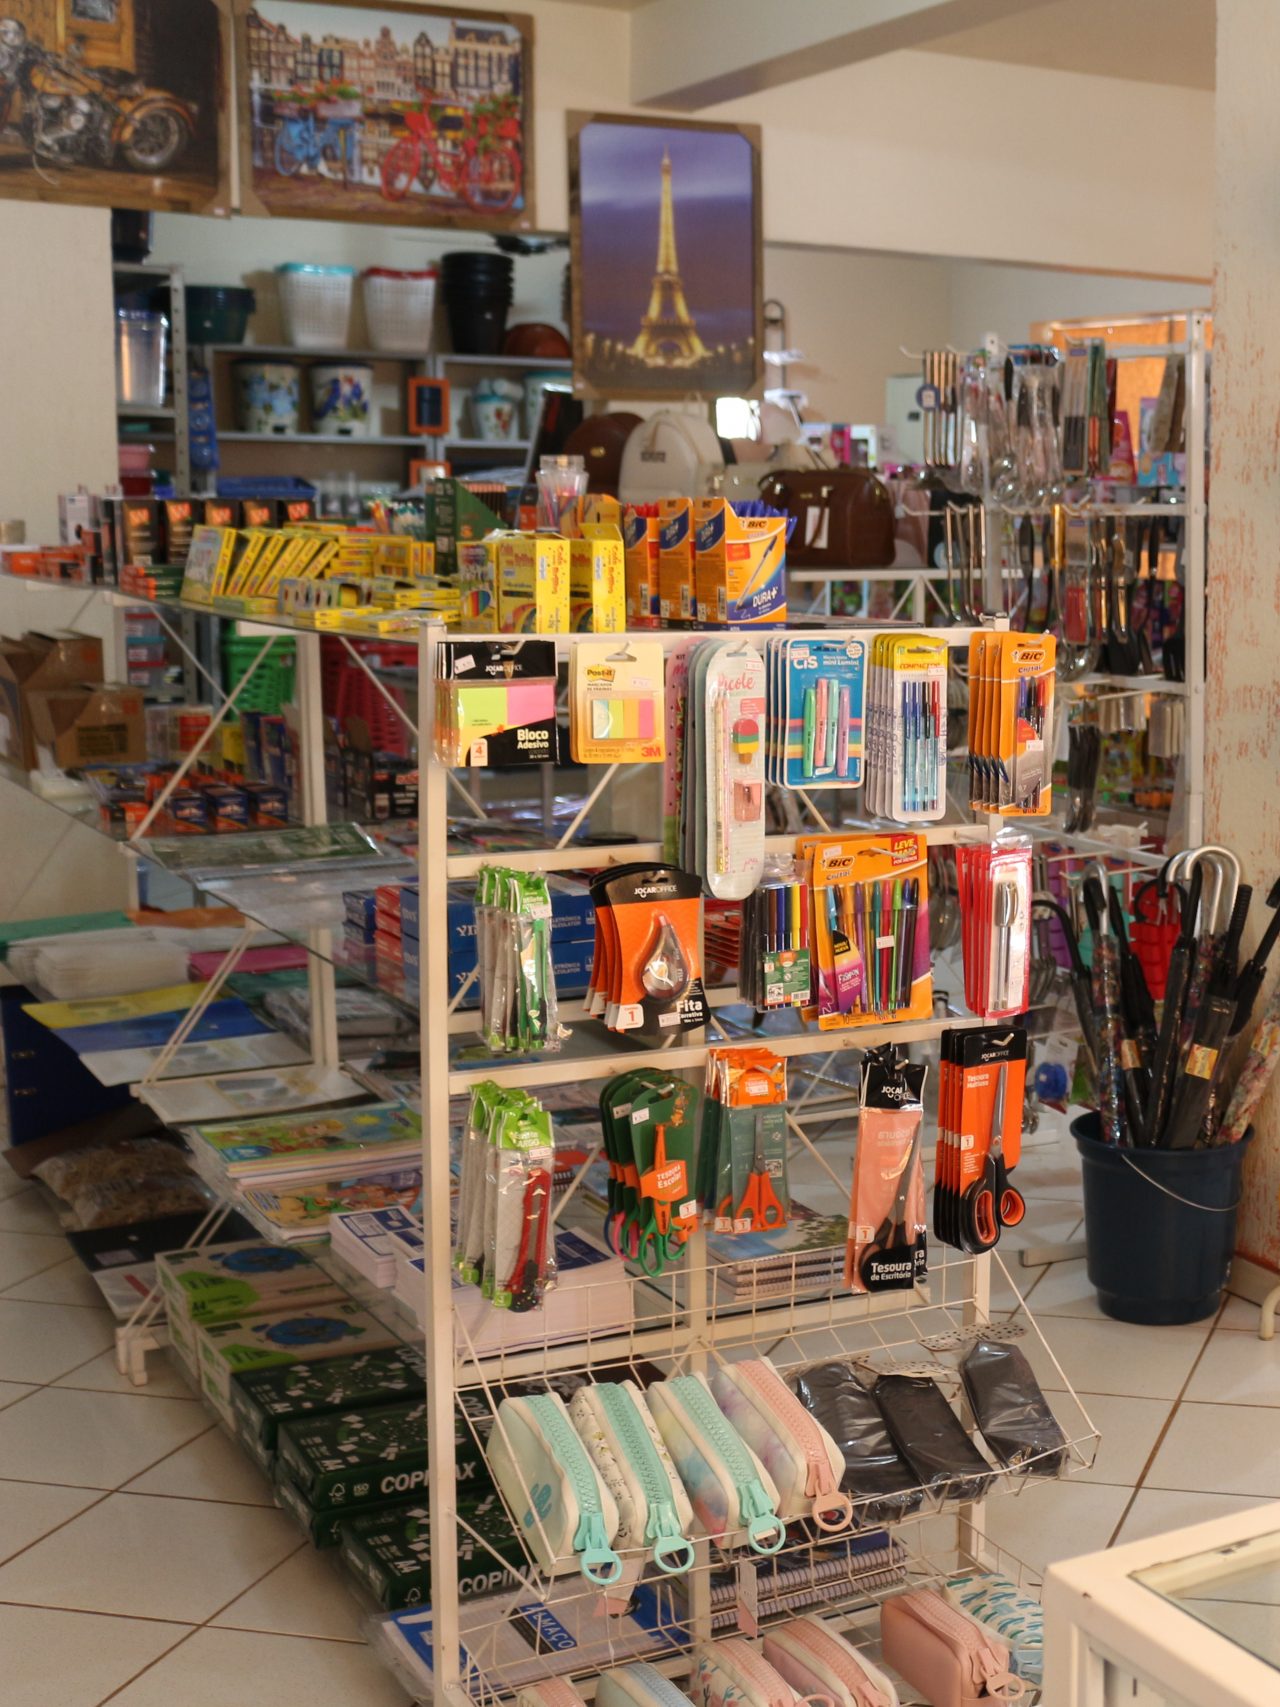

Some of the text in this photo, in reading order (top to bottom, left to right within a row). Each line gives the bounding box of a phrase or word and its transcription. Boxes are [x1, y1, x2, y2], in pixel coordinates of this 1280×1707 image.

[753, 587, 778, 607] DURA+
[587, 668, 613, 677] Post-it
[517, 728, 549, 740] Bloco
[475, 745, 483, 755] 4
[517, 740, 549, 750] Adesivo
[641, 746, 662, 758] 3M
[894, 838, 915, 851] LEVE
[676, 999, 703, 1013] Fita
[628, 1010, 635, 1022] 1
[679, 1011, 704, 1020] orretiva
[871, 1260, 912, 1273] Tesoura
[870, 1270, 912, 1281] de Escritório
[380, 1461, 477, 1494] COPIAX
[394, 1559, 422, 1574] A4
